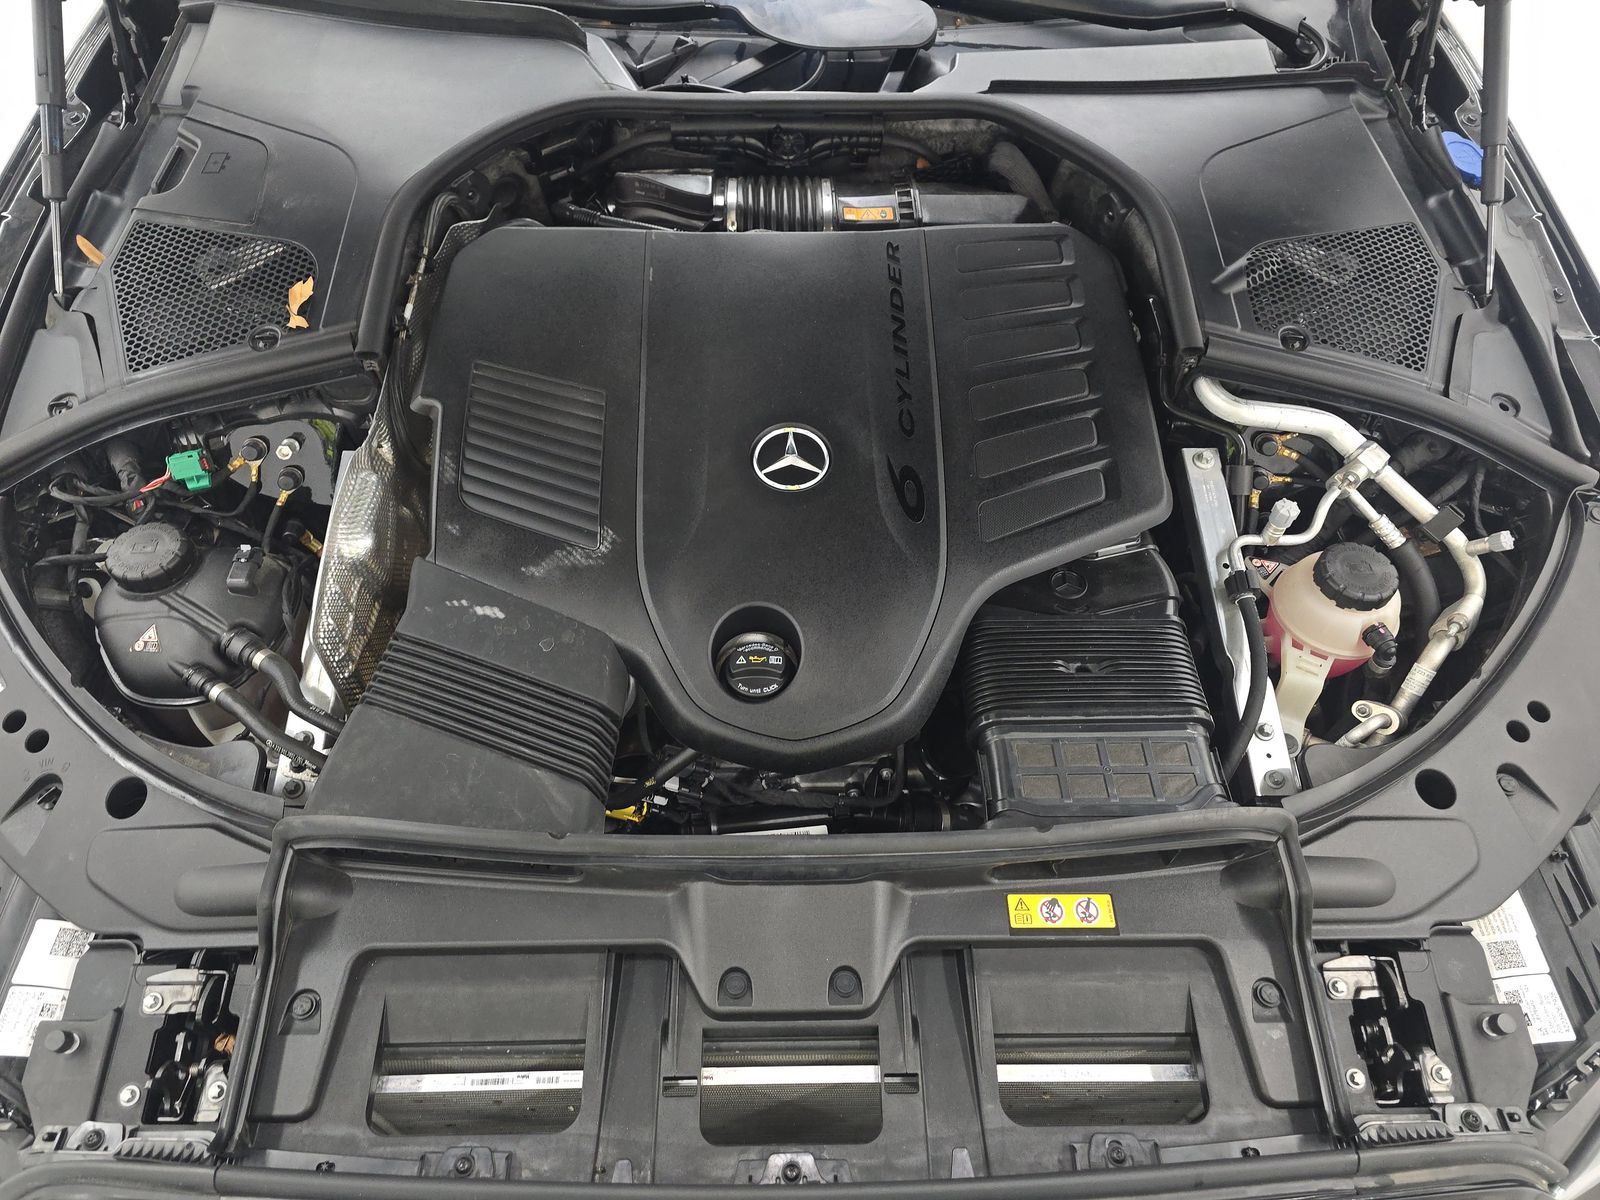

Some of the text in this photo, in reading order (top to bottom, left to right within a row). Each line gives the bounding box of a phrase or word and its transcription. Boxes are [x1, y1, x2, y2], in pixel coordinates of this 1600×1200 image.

[886, 240, 926, 524] 6 CYLINDER
[738, 683, 749, 692] Turn
[763, 683, 778, 693] CLICK
